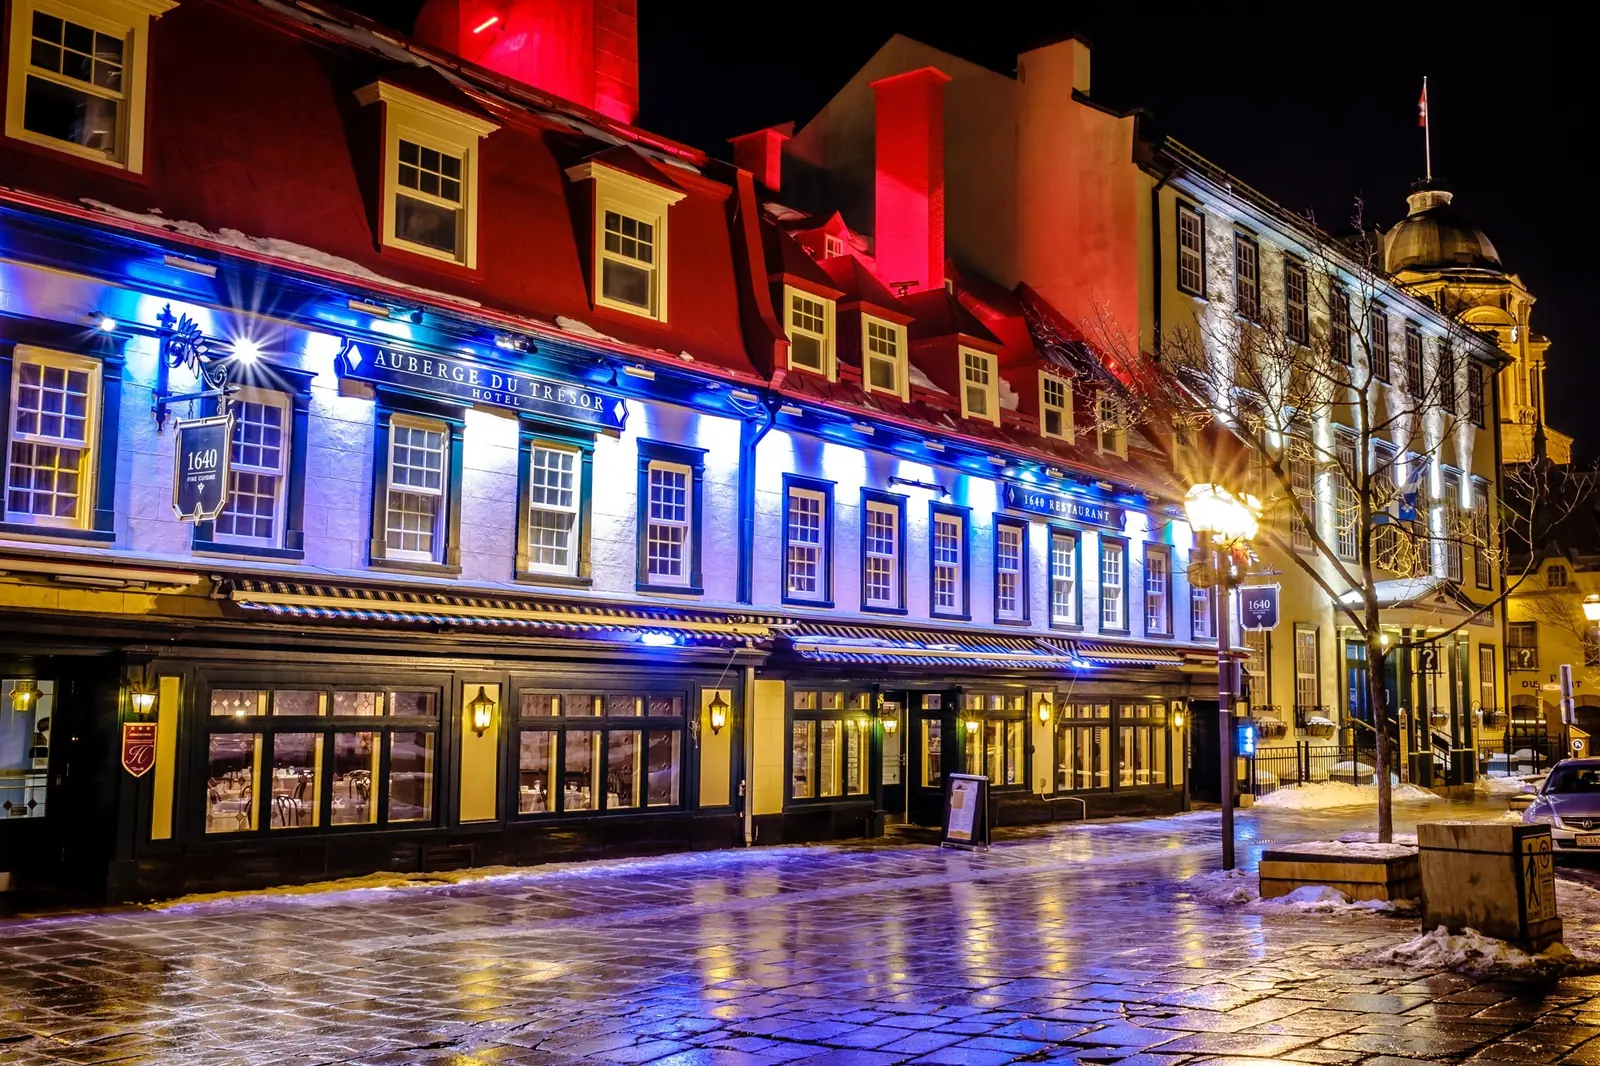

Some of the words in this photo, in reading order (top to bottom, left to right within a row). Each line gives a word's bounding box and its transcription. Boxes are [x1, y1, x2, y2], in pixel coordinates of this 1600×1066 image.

[374, 349, 480, 384] AUBERGE
[491, 373, 519, 392] DU
[530, 382, 604, 411] TRÉSOR
[472, 388, 520, 406] HOTEL
[188, 448, 218, 471] 1640
[1024, 494, 1045, 508] 1640
[1049, 499, 1110, 521] RESTAURANT
[1248, 599, 1271, 610] 1640
